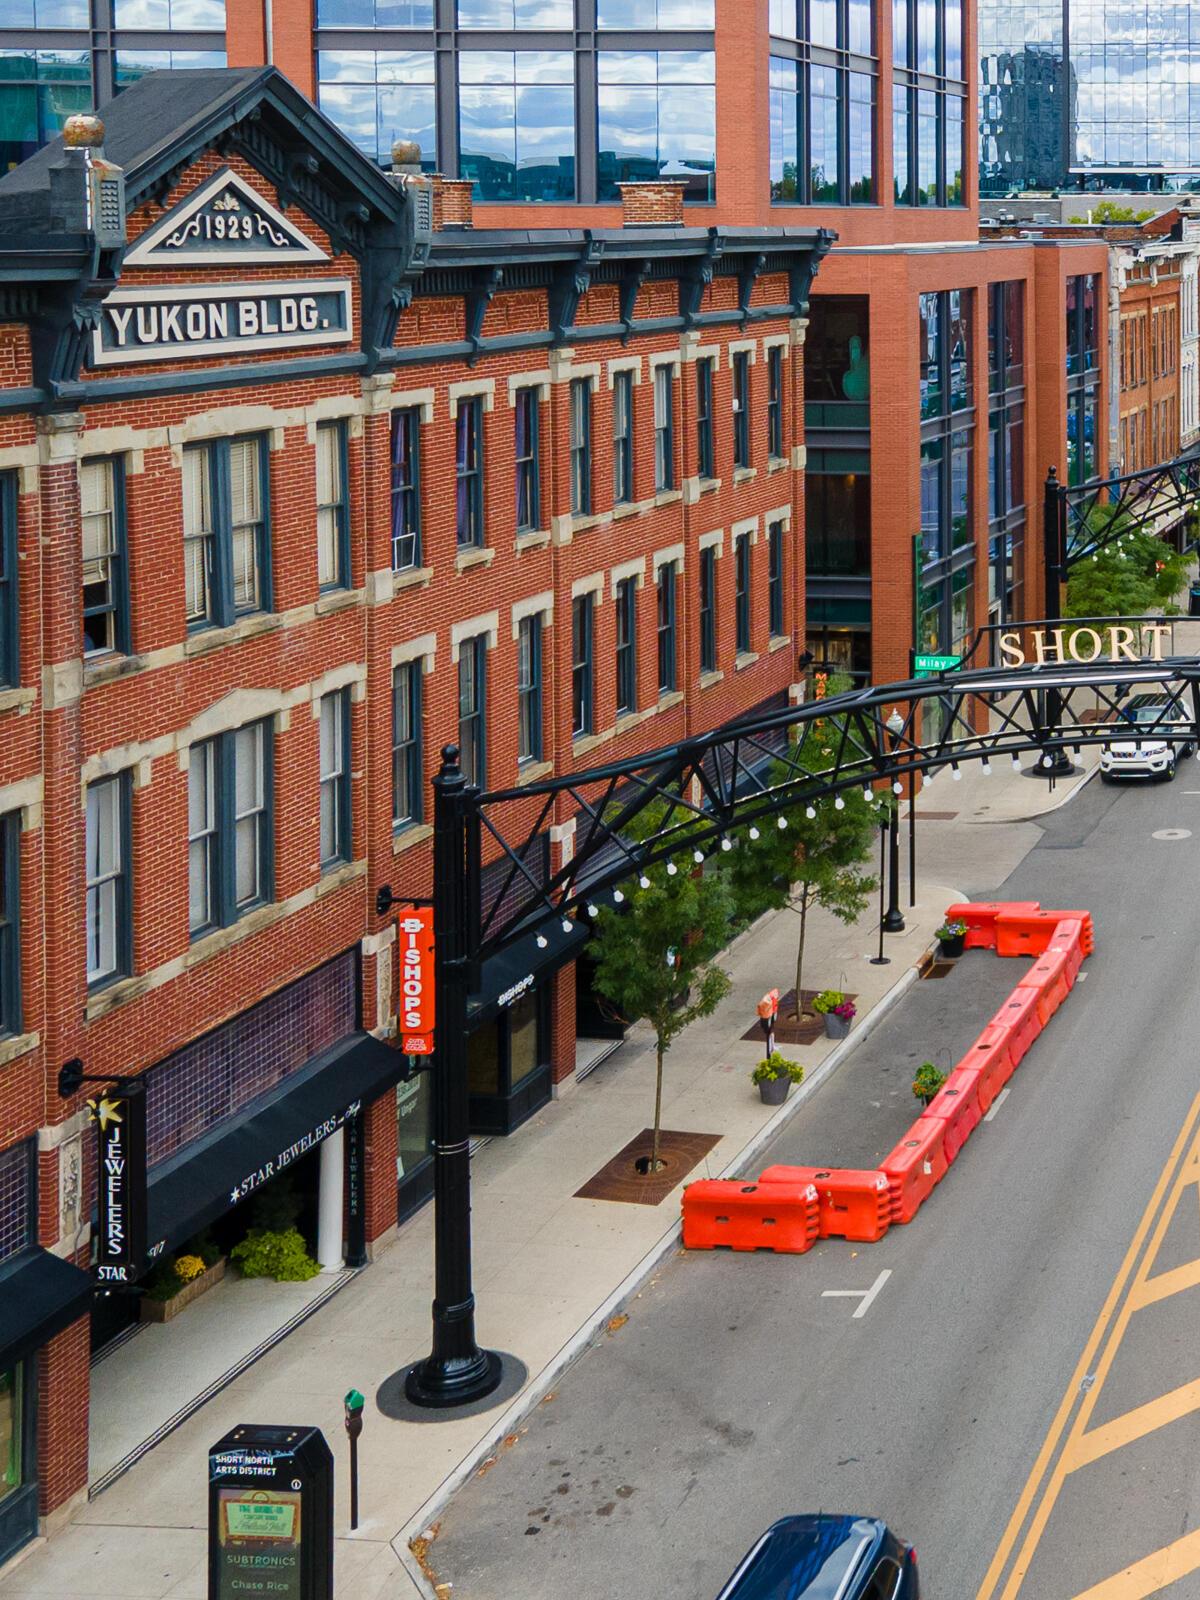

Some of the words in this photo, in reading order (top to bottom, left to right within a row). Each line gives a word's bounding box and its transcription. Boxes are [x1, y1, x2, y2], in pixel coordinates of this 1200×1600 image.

[205, 215, 253, 239] 1929
[109, 303, 228, 346] YUKON
[239, 297, 329, 337] BLDG.
[999, 625, 1172, 669] SHORT
[400, 918, 424, 1028] BISHOPS
[497, 973, 535, 1007] BISHOPS
[240, 1161, 275, 1197] STAR
[276, 1114, 337, 1171] JEWELERS
[104, 1127, 125, 1255] JEWELERS
[98, 1266, 128, 1281] STAR
[215, 1455, 244, 1464] SHORT
[245, 1456, 274, 1465] NORTH
[215, 1466, 237, 1475] ARTS
[239, 1466, 277, 1476] DISTRICT
[226, 1555, 296, 1567] SUBTRONICS
[231, 1580, 263, 1590] Chase
[267, 1581, 289, 1591] Rice
